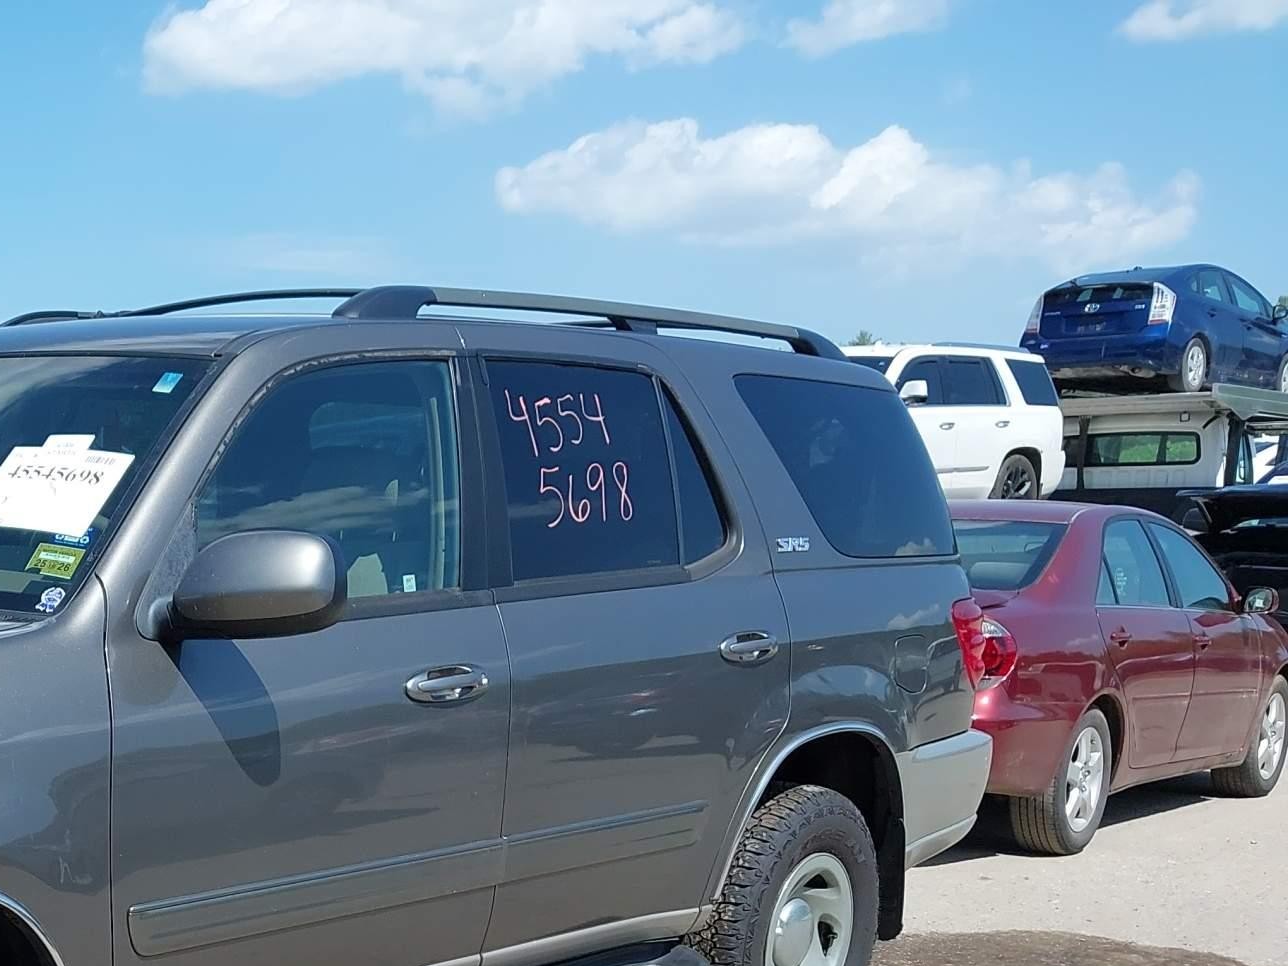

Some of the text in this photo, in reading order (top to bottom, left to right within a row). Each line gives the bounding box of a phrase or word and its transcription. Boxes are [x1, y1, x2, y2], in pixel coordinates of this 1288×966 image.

[505, 389, 610, 457] 4554
[7, 464, 105, 486] 45545698
[540, 462, 633, 528] 5698
